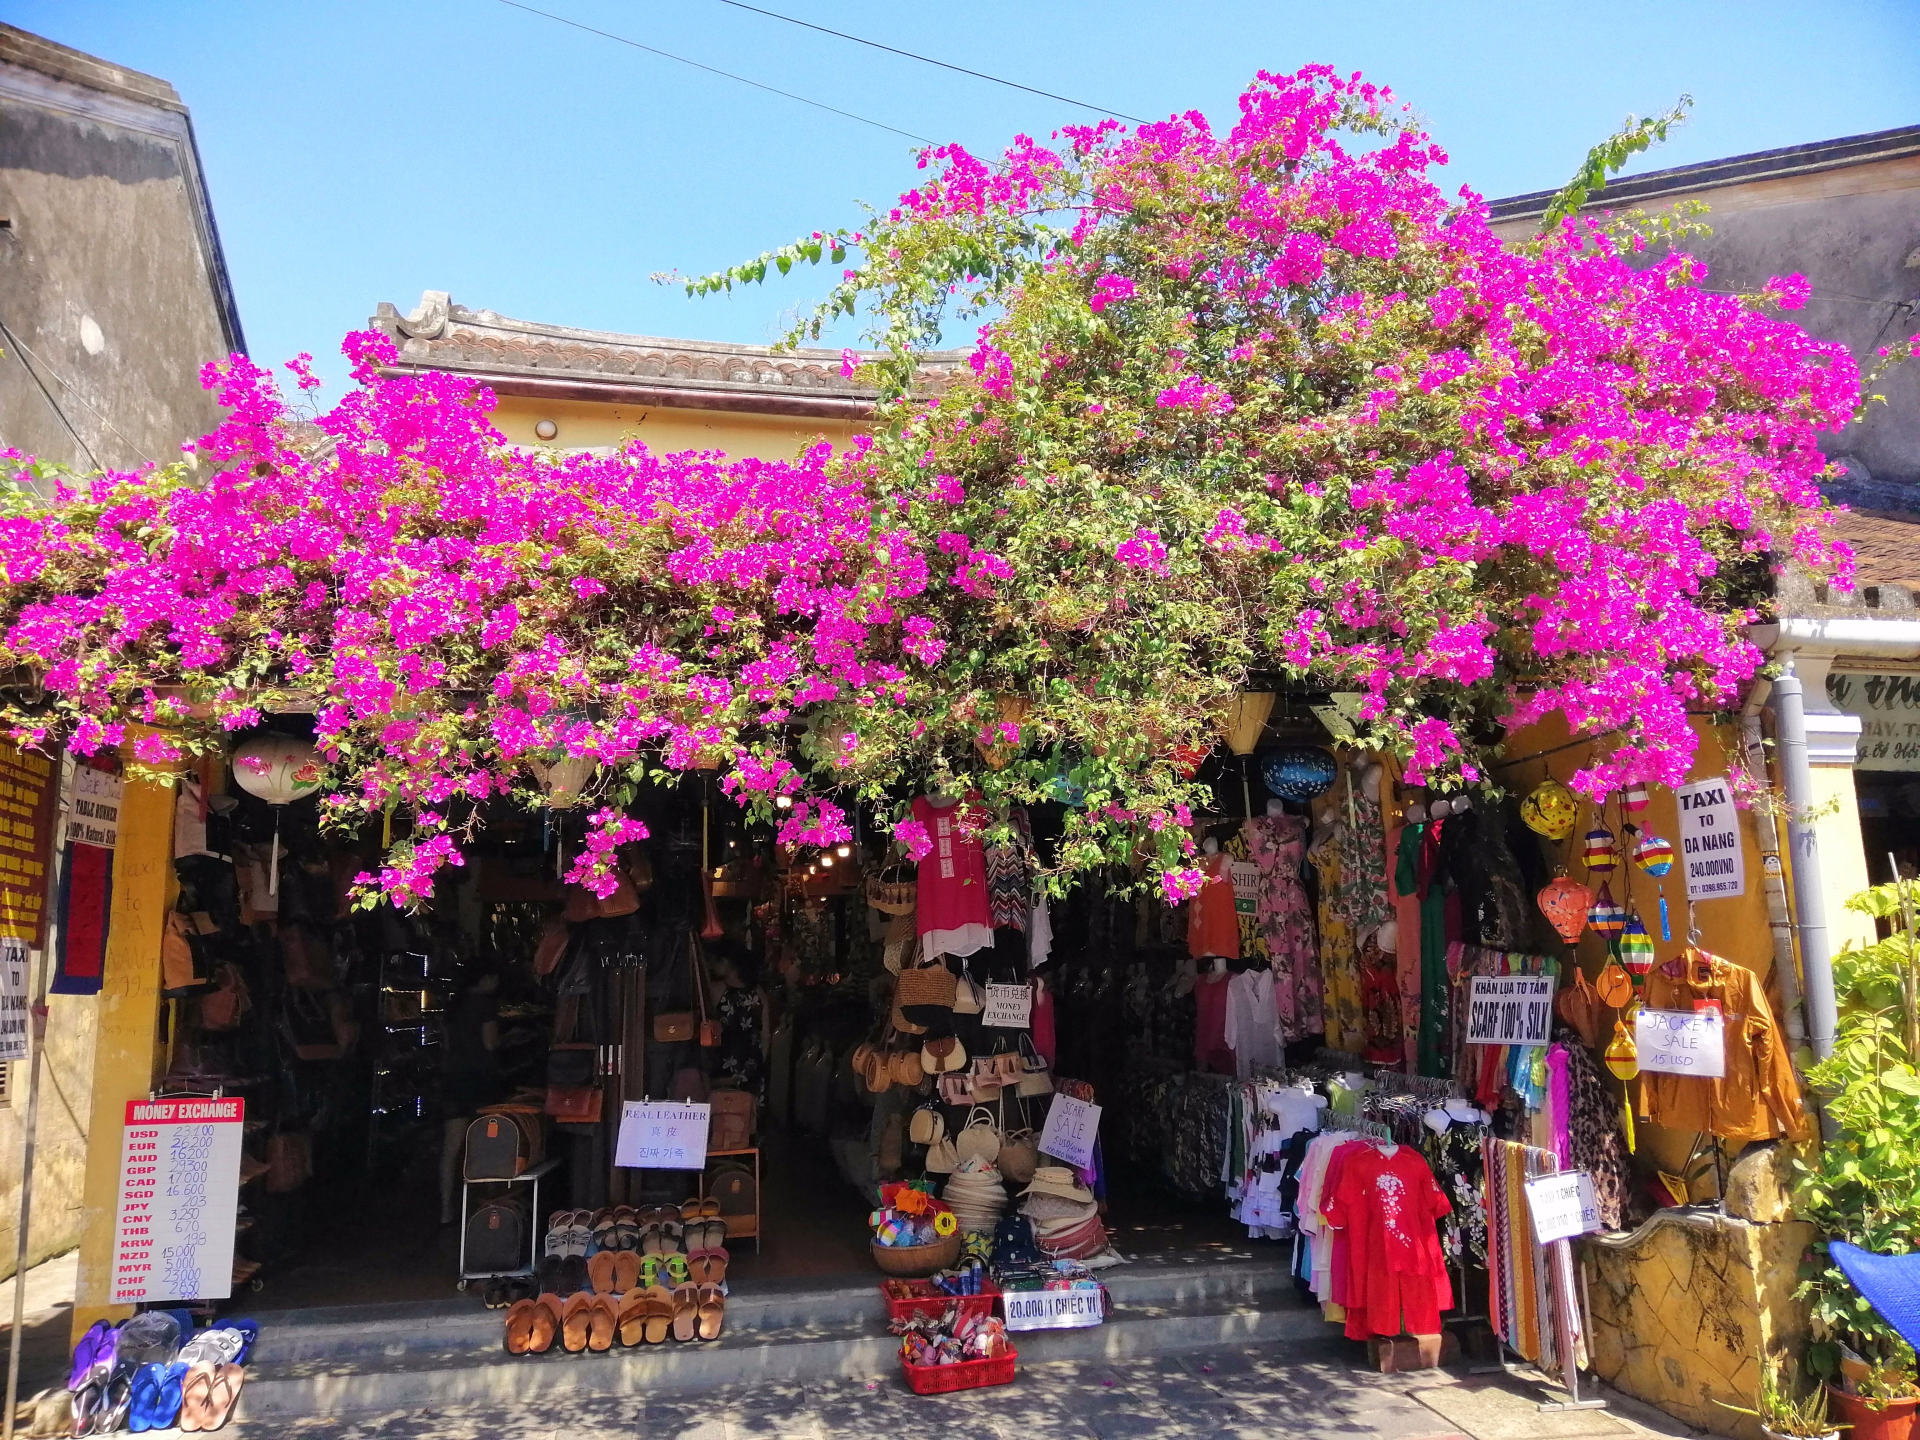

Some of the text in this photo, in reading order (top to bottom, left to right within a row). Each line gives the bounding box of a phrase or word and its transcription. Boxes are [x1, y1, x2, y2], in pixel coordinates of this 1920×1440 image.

[1680, 788, 1726, 810] TAXI
[76, 799, 117, 822] TABLE RUNNER
[1699, 814, 1714, 827] TO
[85, 825, 106, 843] Natural
[106, 829, 116, 845] Silk
[1685, 832, 1734, 853] DA NANG
[6, 947, 28, 962] TAXI
[12, 971, 20, 986] TO
[990, 986, 1028, 1000] 货币兑换
[1475, 980, 1498, 994] KHĂN
[1500, 982, 1514, 997] LỤA
[11, 996, 27, 1011] NANG
[996, 1002, 1020, 1010] MONEY
[988, 1012, 1027, 1020] EXCHANGE
[1471, 1001, 1549, 1040] SCARF 100% SILK
[1647, 1013, 1715, 1032] JACKET
[1662, 1035, 1698, 1049] SALE
[1651, 1054, 1693, 1065] 15 USD
[133, 1103, 237, 1120] MONEY EXCHANGE
[625, 1110, 706, 1120] REAL LEATHER
[1063, 1102, 1086, 1118] SCARF
[130, 1130, 158, 1138] USD
[1053, 1115, 1085, 1139] SALE
[639, 1147, 684, 1159] 진짜 가죽
[126, 1179, 156, 1187] CAD
[1560, 1182, 1580, 1199] CHIẾC
[125, 1191, 154, 1199] SGD
[123, 1196, 207, 1211] JPY 203
[123, 1215, 153, 1223] CNY
[1575, 1205, 1595, 1223] CHIẾC
[122, 1220, 199, 1235] THB 670
[121, 1239, 154, 1248] KRW
[120, 1252, 149, 1260] NZD
[119, 1264, 152, 1272] MYR
[118, 1276, 145, 1285] CHF
[117, 1289, 146, 1297] HKD
[1010, 1292, 1096, 1319] 20.000/1 CHIẾC VÍ
